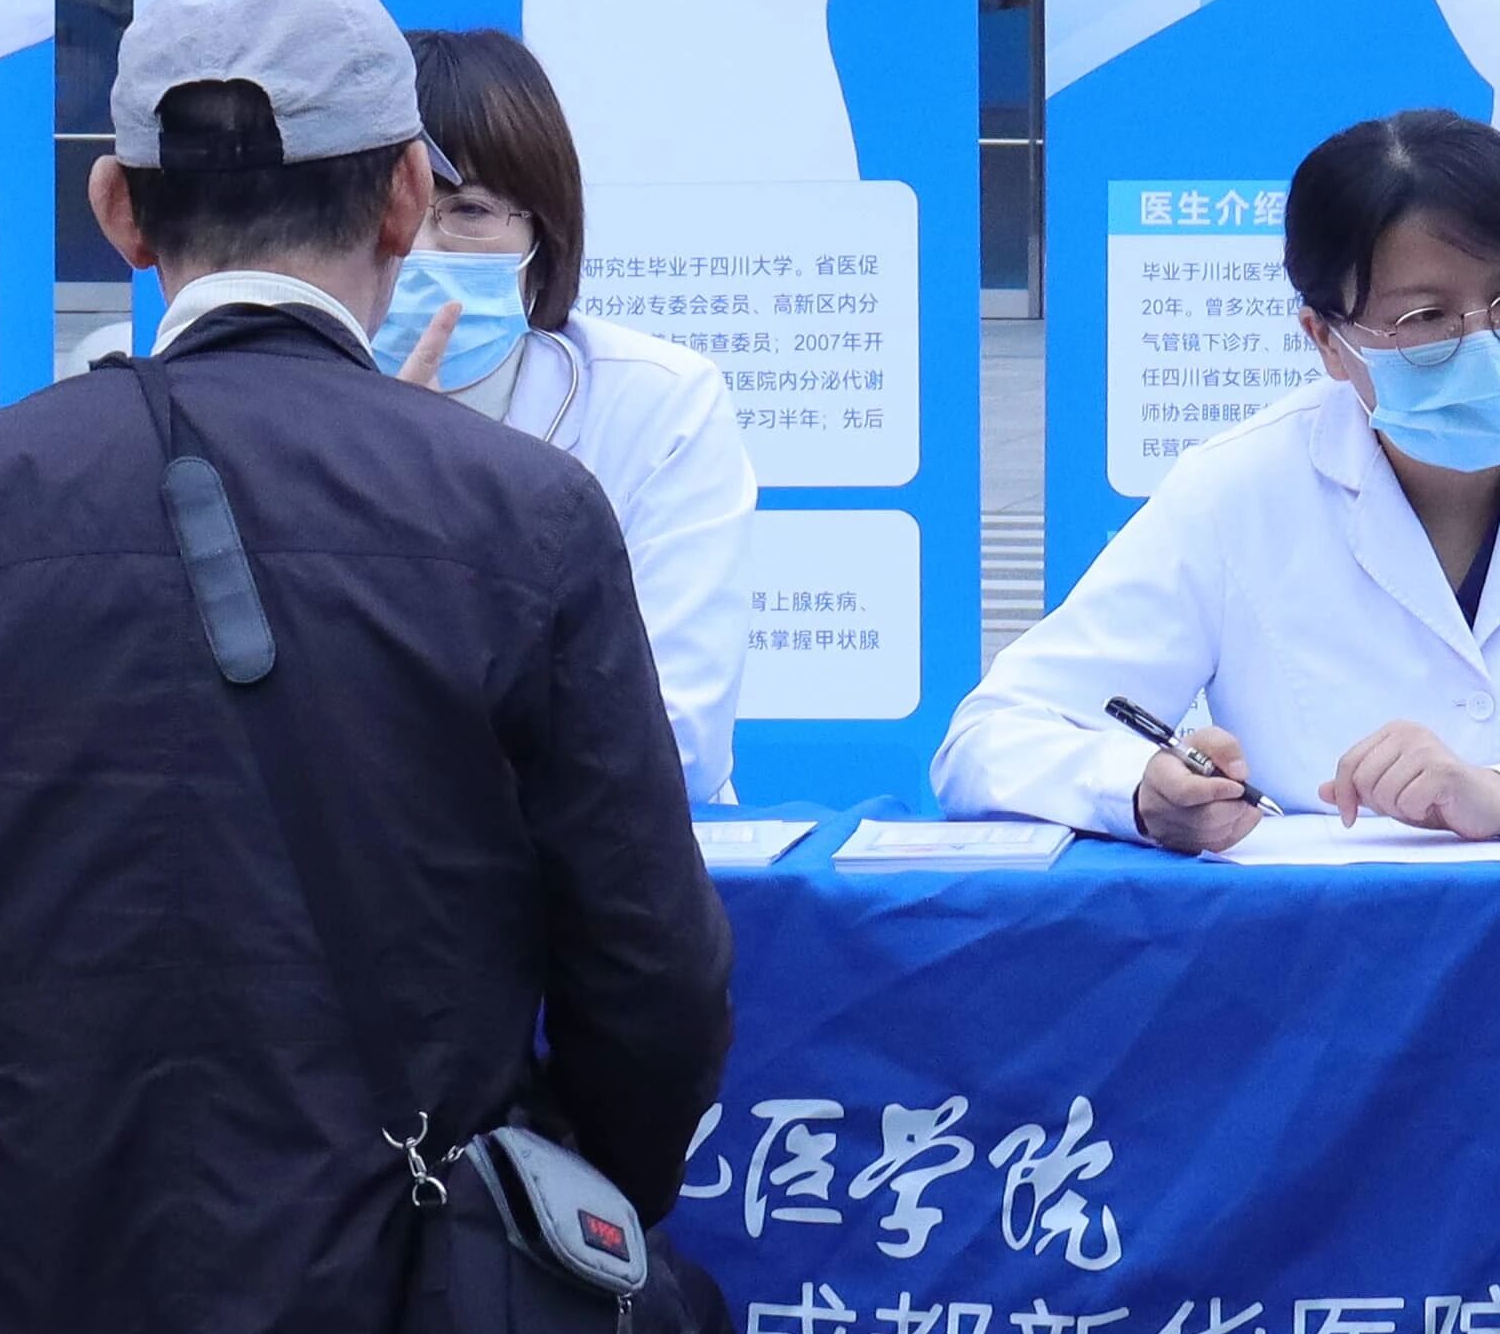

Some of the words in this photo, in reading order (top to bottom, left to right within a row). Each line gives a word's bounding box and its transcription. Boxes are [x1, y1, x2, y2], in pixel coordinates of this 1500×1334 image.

[1140, 189, 1285, 227] 医生介绍
[1142, 261, 1290, 282] 毕业于川北医学
[651, 331, 883, 355] 与筛查委员；2007年开
[736, 408, 884, 431] 学习半年；先后
[1142, 402, 1270, 423] 师协会睡眠医
[747, 629, 880, 651] 练掌握甲状腺
